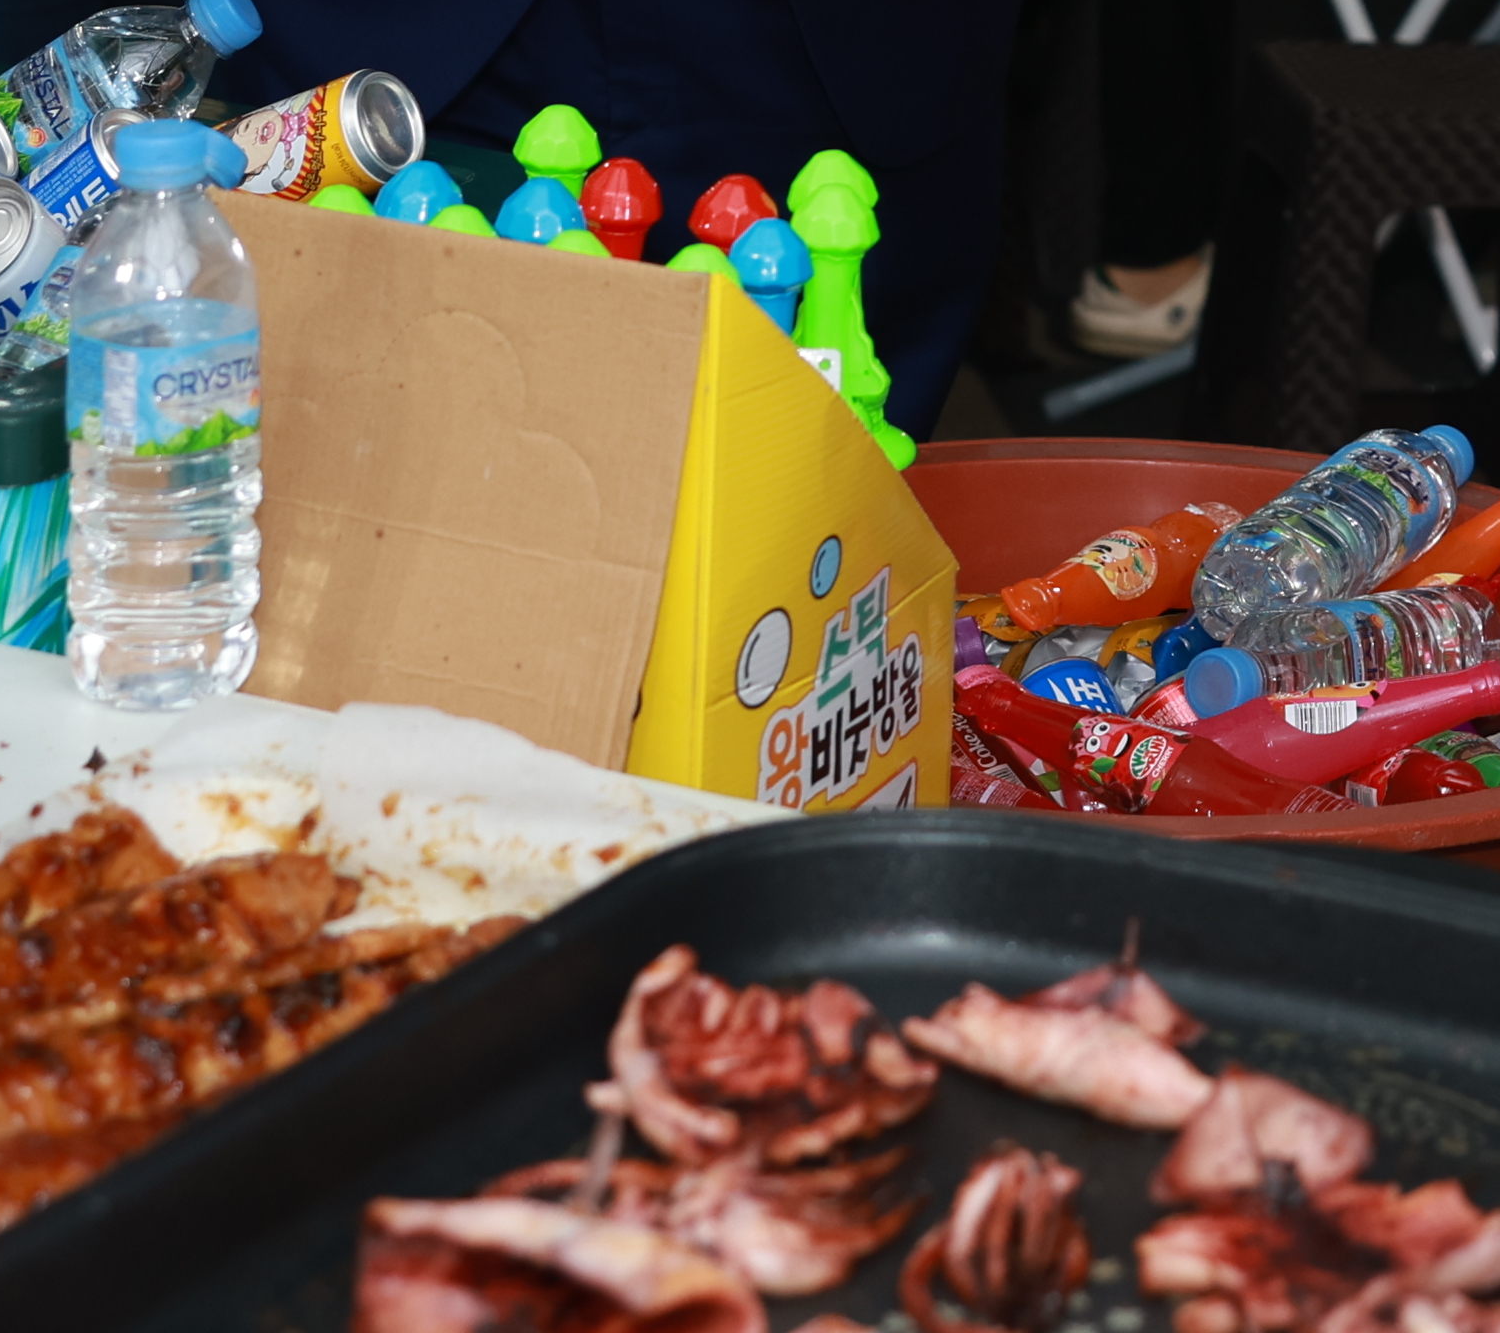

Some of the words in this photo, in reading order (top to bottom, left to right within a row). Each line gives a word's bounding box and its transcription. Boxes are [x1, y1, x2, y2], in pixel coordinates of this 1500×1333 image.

[816, 575, 887, 711] 스틱
[811, 642, 921, 787] 비눗방울
[1152, 746, 1175, 778] CHERRY
